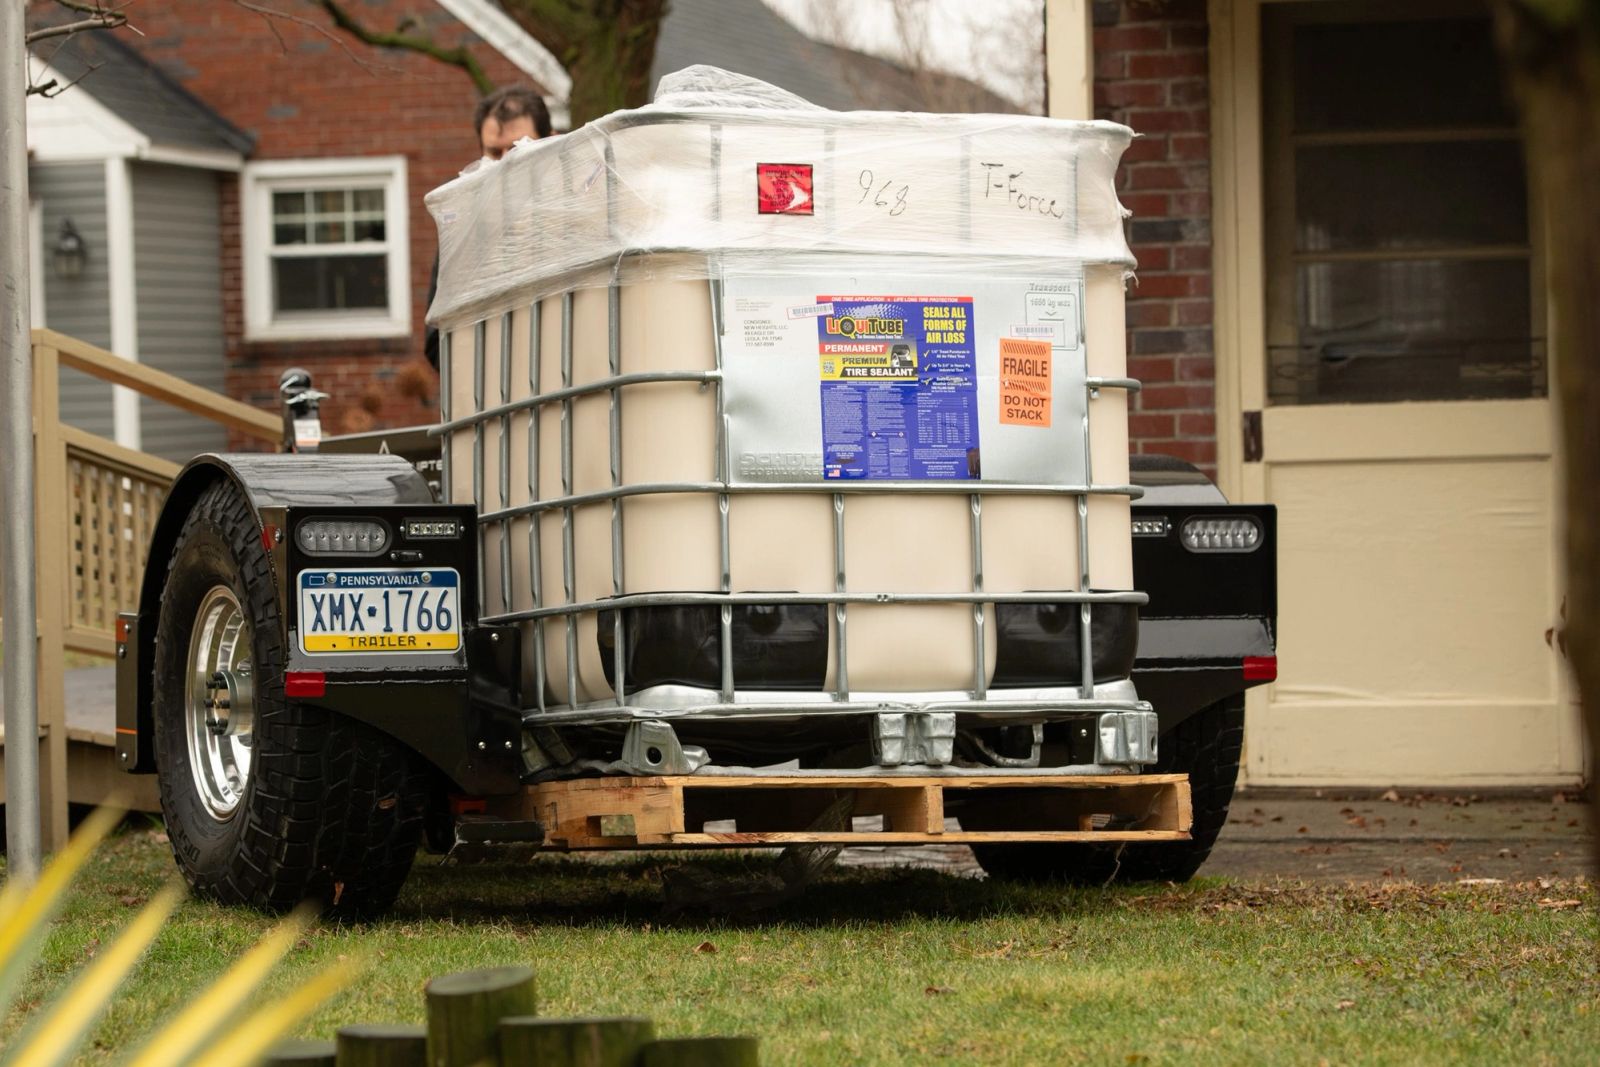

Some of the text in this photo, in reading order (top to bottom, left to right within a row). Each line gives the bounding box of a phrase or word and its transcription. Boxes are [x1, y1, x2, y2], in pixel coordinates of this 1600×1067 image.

[858, 169, 910, 217] 968
[980, 162, 1065, 219] T-Force
[923, 307, 966, 318] SEALS ALL
[923, 319, 967, 331] FORMS OF
[926, 332, 966, 344] AIR LOSS
[824, 344, 884, 353] PERMANENT
[842, 357, 888, 365] PREMIUM
[845, 368, 914, 376] TIRE SEALANT
[1003, 357, 1048, 378] FRAGILE
[1004, 395, 1047, 408] DO NOT
[1007, 408, 1043, 421] STACK
[340, 575, 420, 586] PENNSYLVANIA
[348, 635, 417, 647] TRAILER
